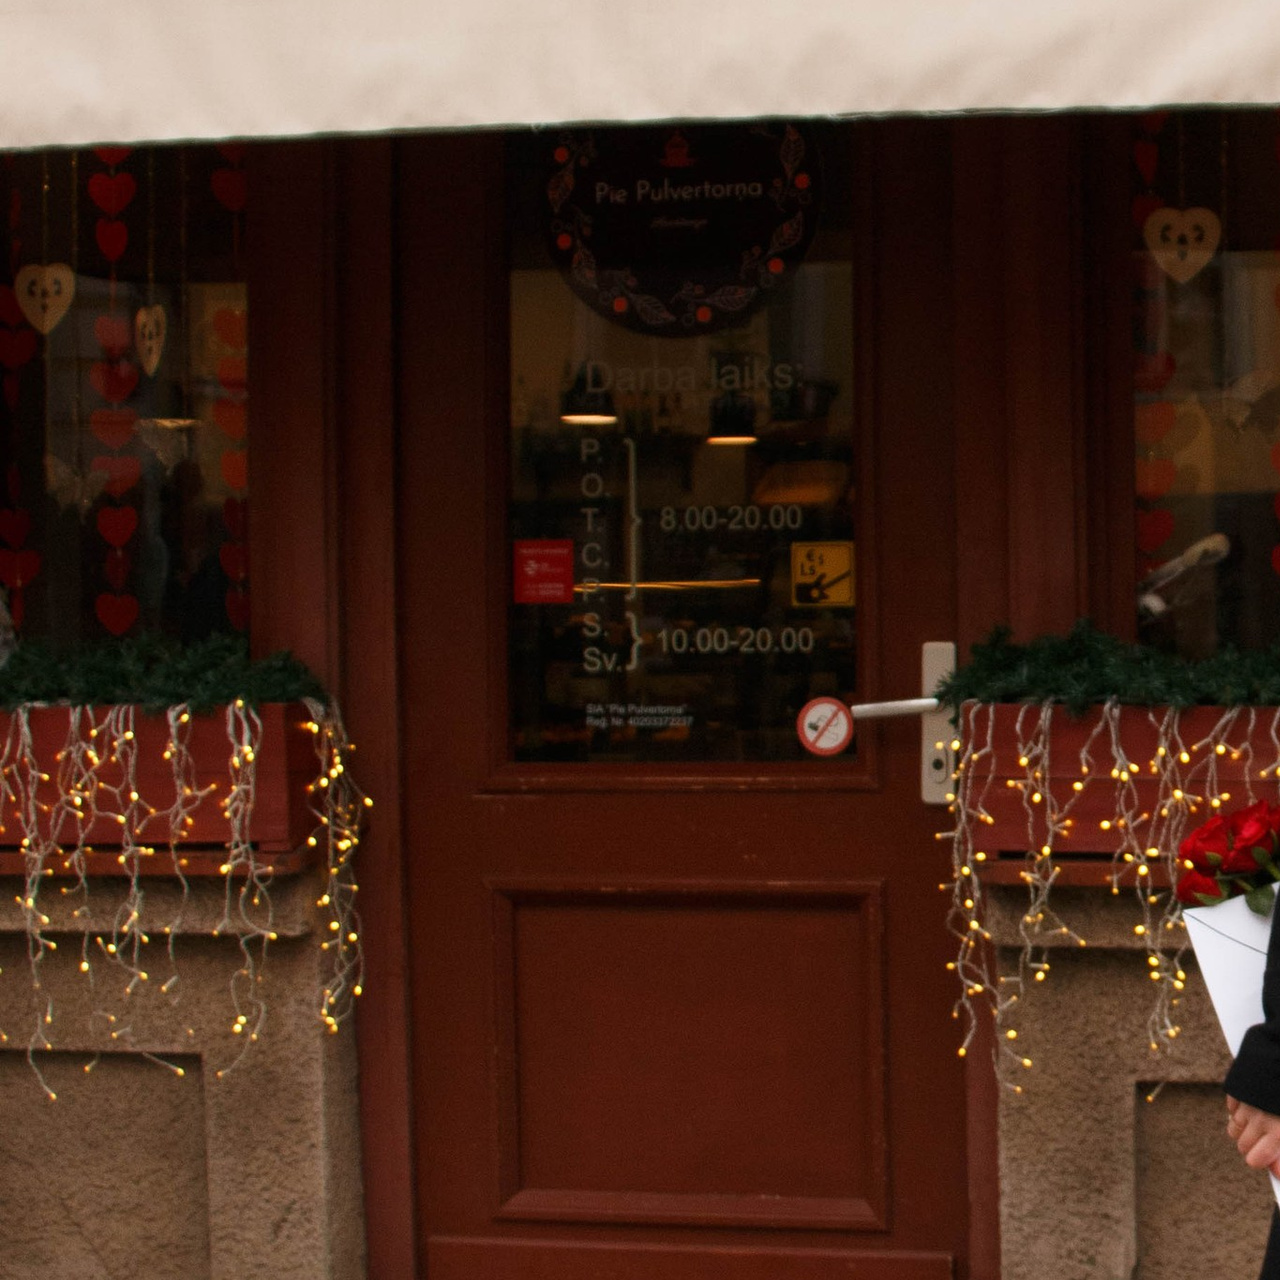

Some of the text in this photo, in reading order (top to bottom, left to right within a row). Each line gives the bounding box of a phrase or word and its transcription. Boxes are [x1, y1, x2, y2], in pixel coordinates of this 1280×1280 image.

[595, 181, 628, 205] Pie
[586, 356, 803, 393] Darba laiks:
[581, 472, 611, 498] O.
[581, 507, 603, 532] T.
[660, 504, 802, 531] 8.00-20.00
[581, 541, 610, 568] C.
[582, 612, 608, 638] S.
[657, 626, 814, 653] 10.00-20.00
[582, 646, 622, 672] Sv.
